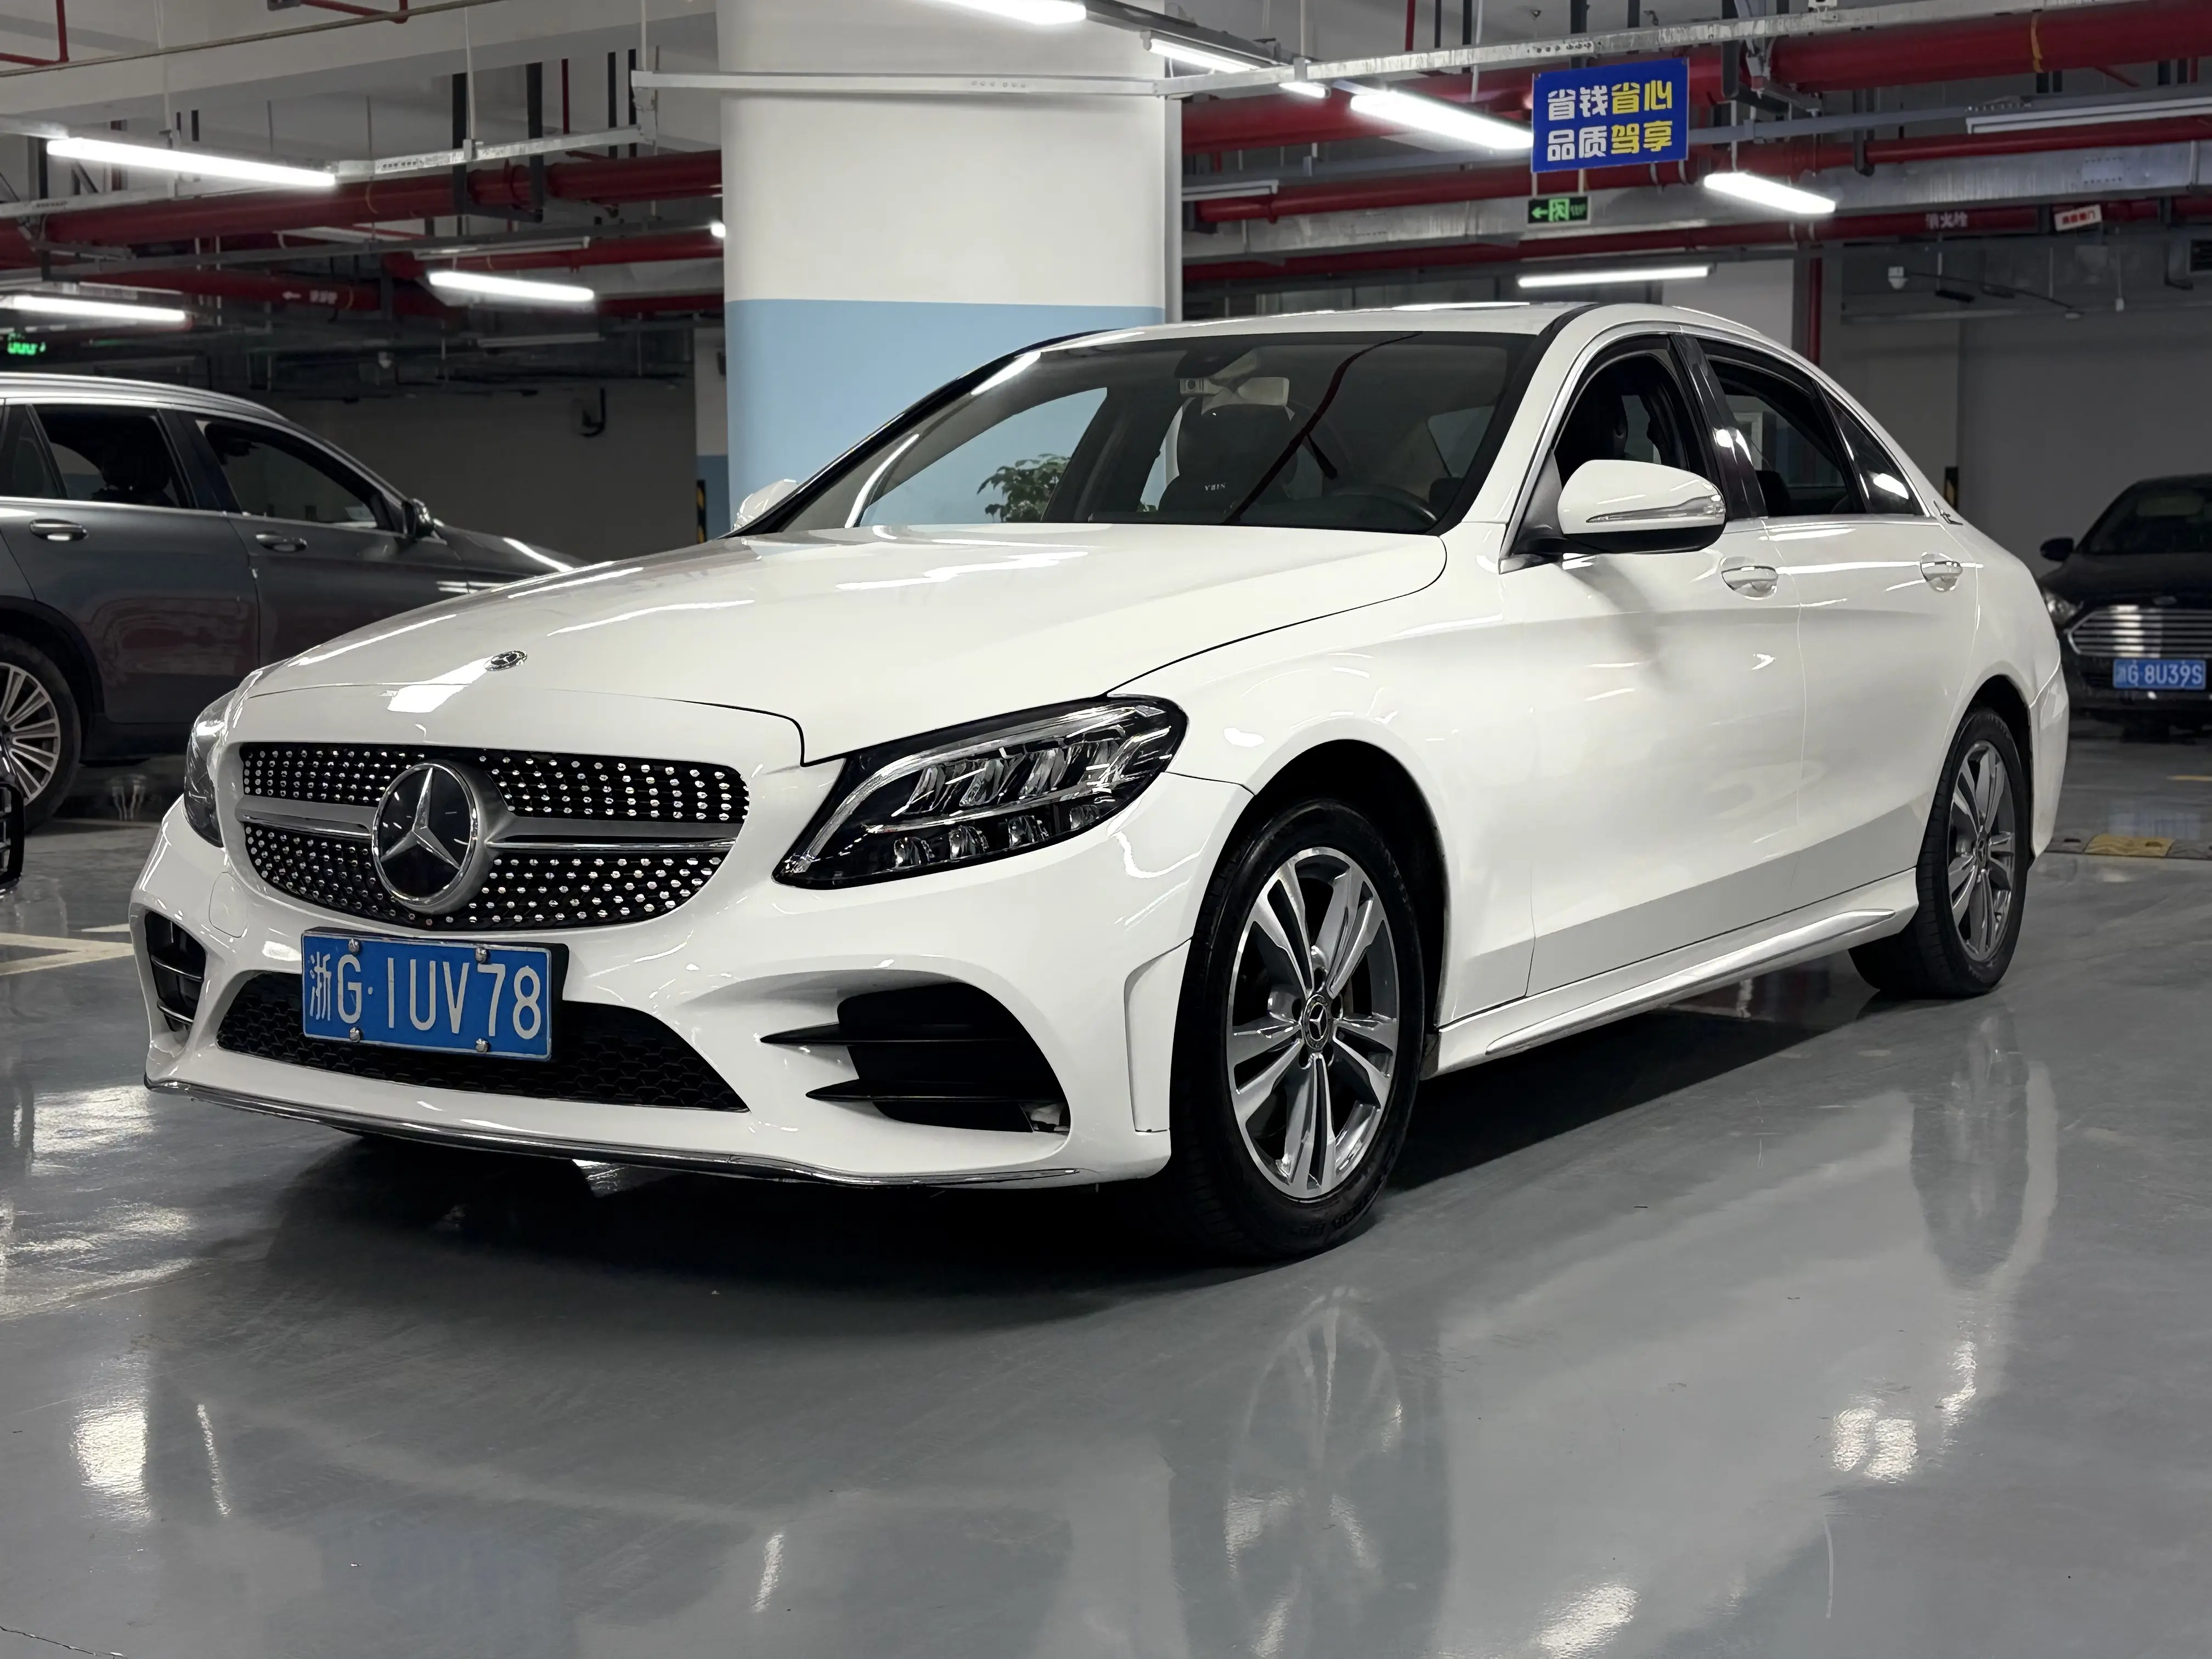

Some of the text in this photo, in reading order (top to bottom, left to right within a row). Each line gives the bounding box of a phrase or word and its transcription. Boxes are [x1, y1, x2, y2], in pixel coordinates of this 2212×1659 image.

[1548, 80, 1672, 121] 省钱省心
[1547, 121, 1672, 161] 品质驾享
